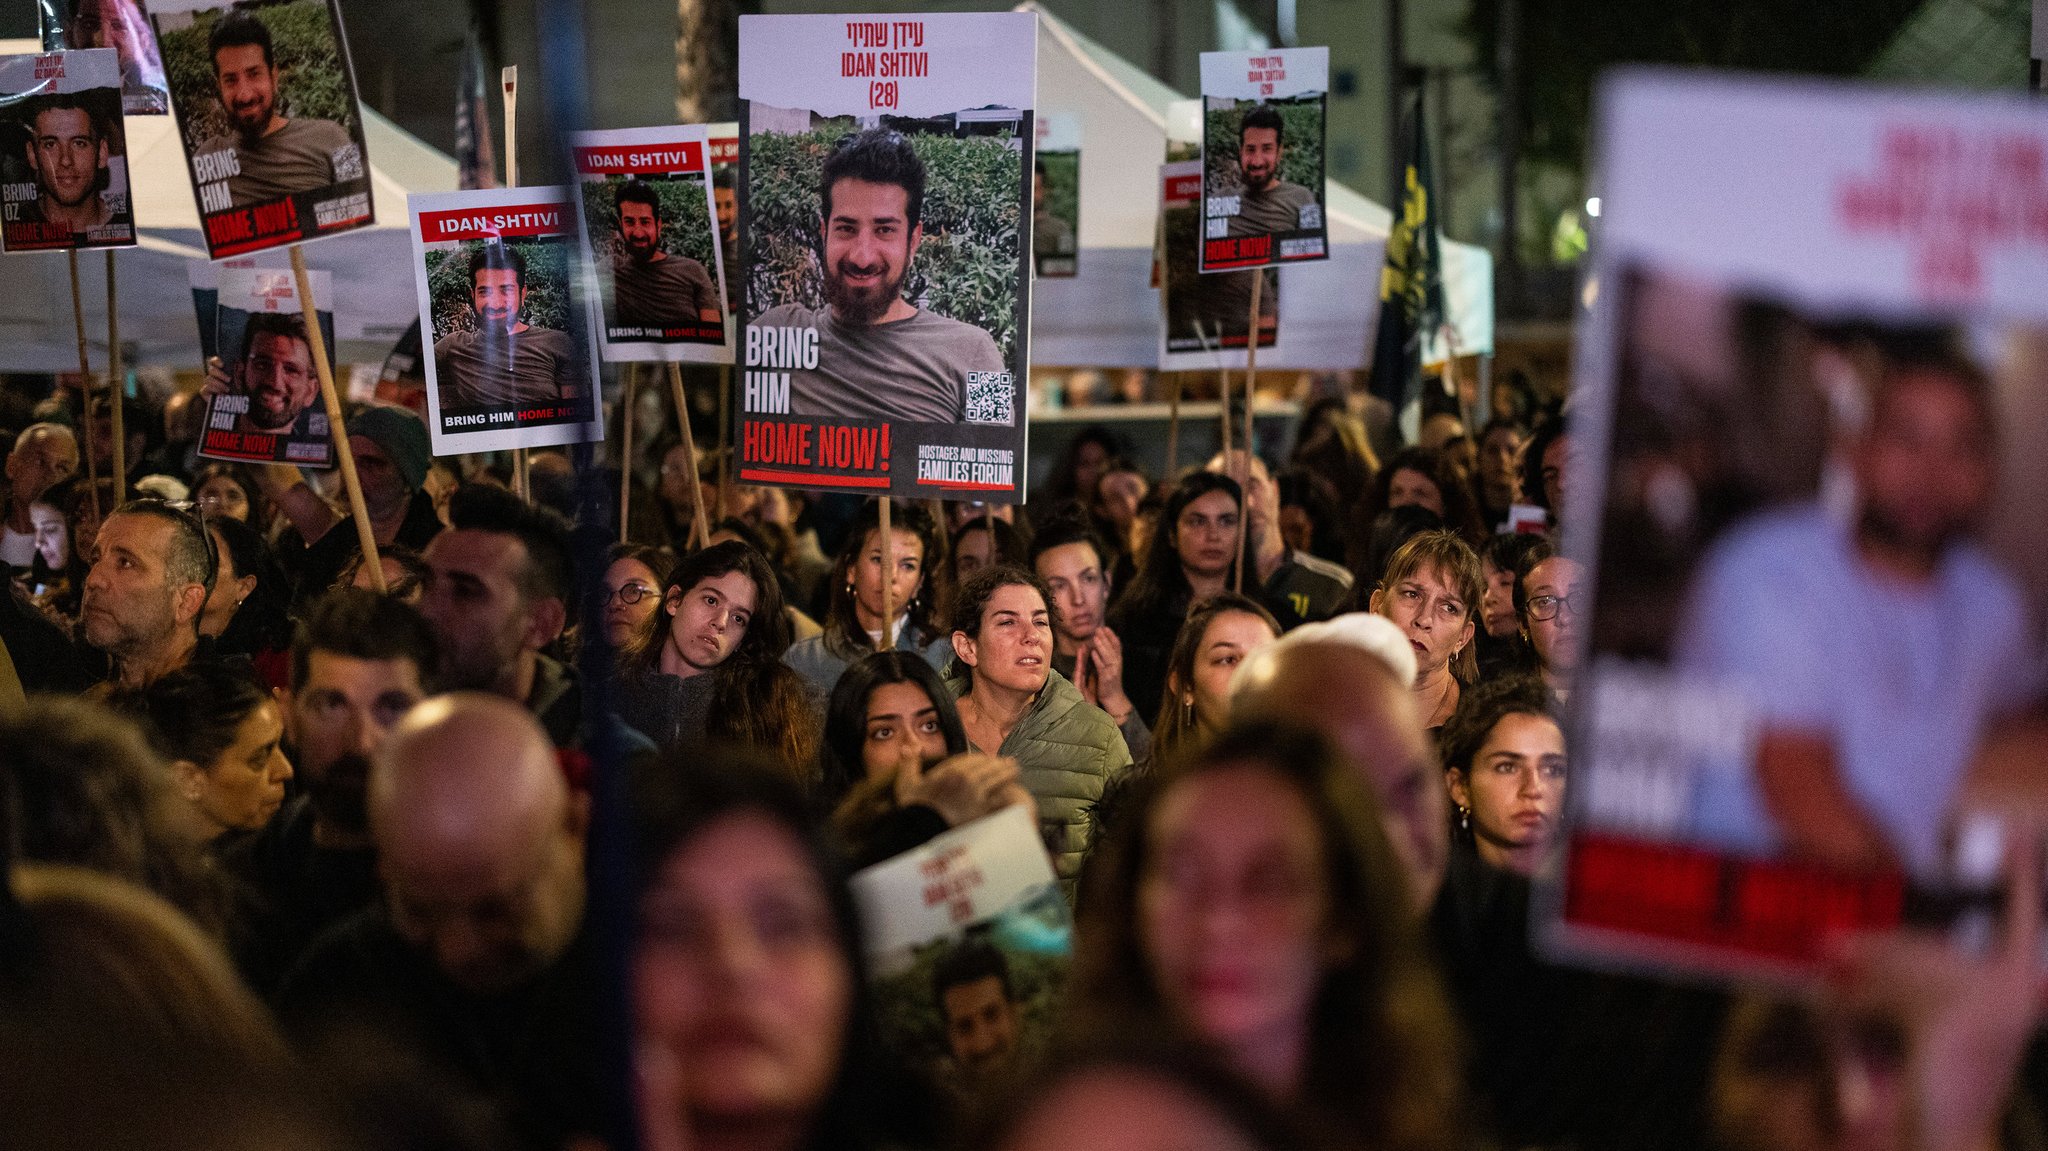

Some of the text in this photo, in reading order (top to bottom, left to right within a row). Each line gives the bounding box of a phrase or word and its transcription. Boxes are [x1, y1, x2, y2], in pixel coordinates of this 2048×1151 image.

[846, 22, 923, 50] עידן שתיוי
[841, 52, 928, 77] IDAN SHTIVI
[869, 80, 899, 110] (28)
[192, 147, 241, 185] BRING
[587, 151, 687, 167] IDAN SHTIVI
[2, 182, 38, 202] BRING
[200, 180, 233, 214] HIM
[4, 202, 21, 221] OZ
[1206, 195, 1241, 218] BRING
[207, 209, 253, 245] HOME
[254, 195, 298, 235] NOW!
[439, 212, 559, 233] IDAN SHTIVI
[1206, 217, 1228, 239] HIM
[1205, 239, 1238, 261] HOME
[1239, 232, 1272, 258] NOW!
[609, 327, 643, 338] BRING
[645, 328, 663, 338] HIM
[665, 327, 697, 337] HOME
[745, 324, 820, 370] BRING
[214, 394, 249, 414] BRING
[744, 370, 791, 415] HIM
[210, 411, 235, 431] HIM
[445, 414, 486, 427] BRING
[489, 411, 514, 424] HIM
[518, 408, 554, 421] HOME
[206, 430, 240, 450] HOME
[243, 433, 277, 454] NOW!
[744, 420, 891, 472] HOME NOW!
[918, 444, 1014, 465] HOSTAGES AND MISSING
[918, 459, 1013, 486] FAMILIES FORUM
